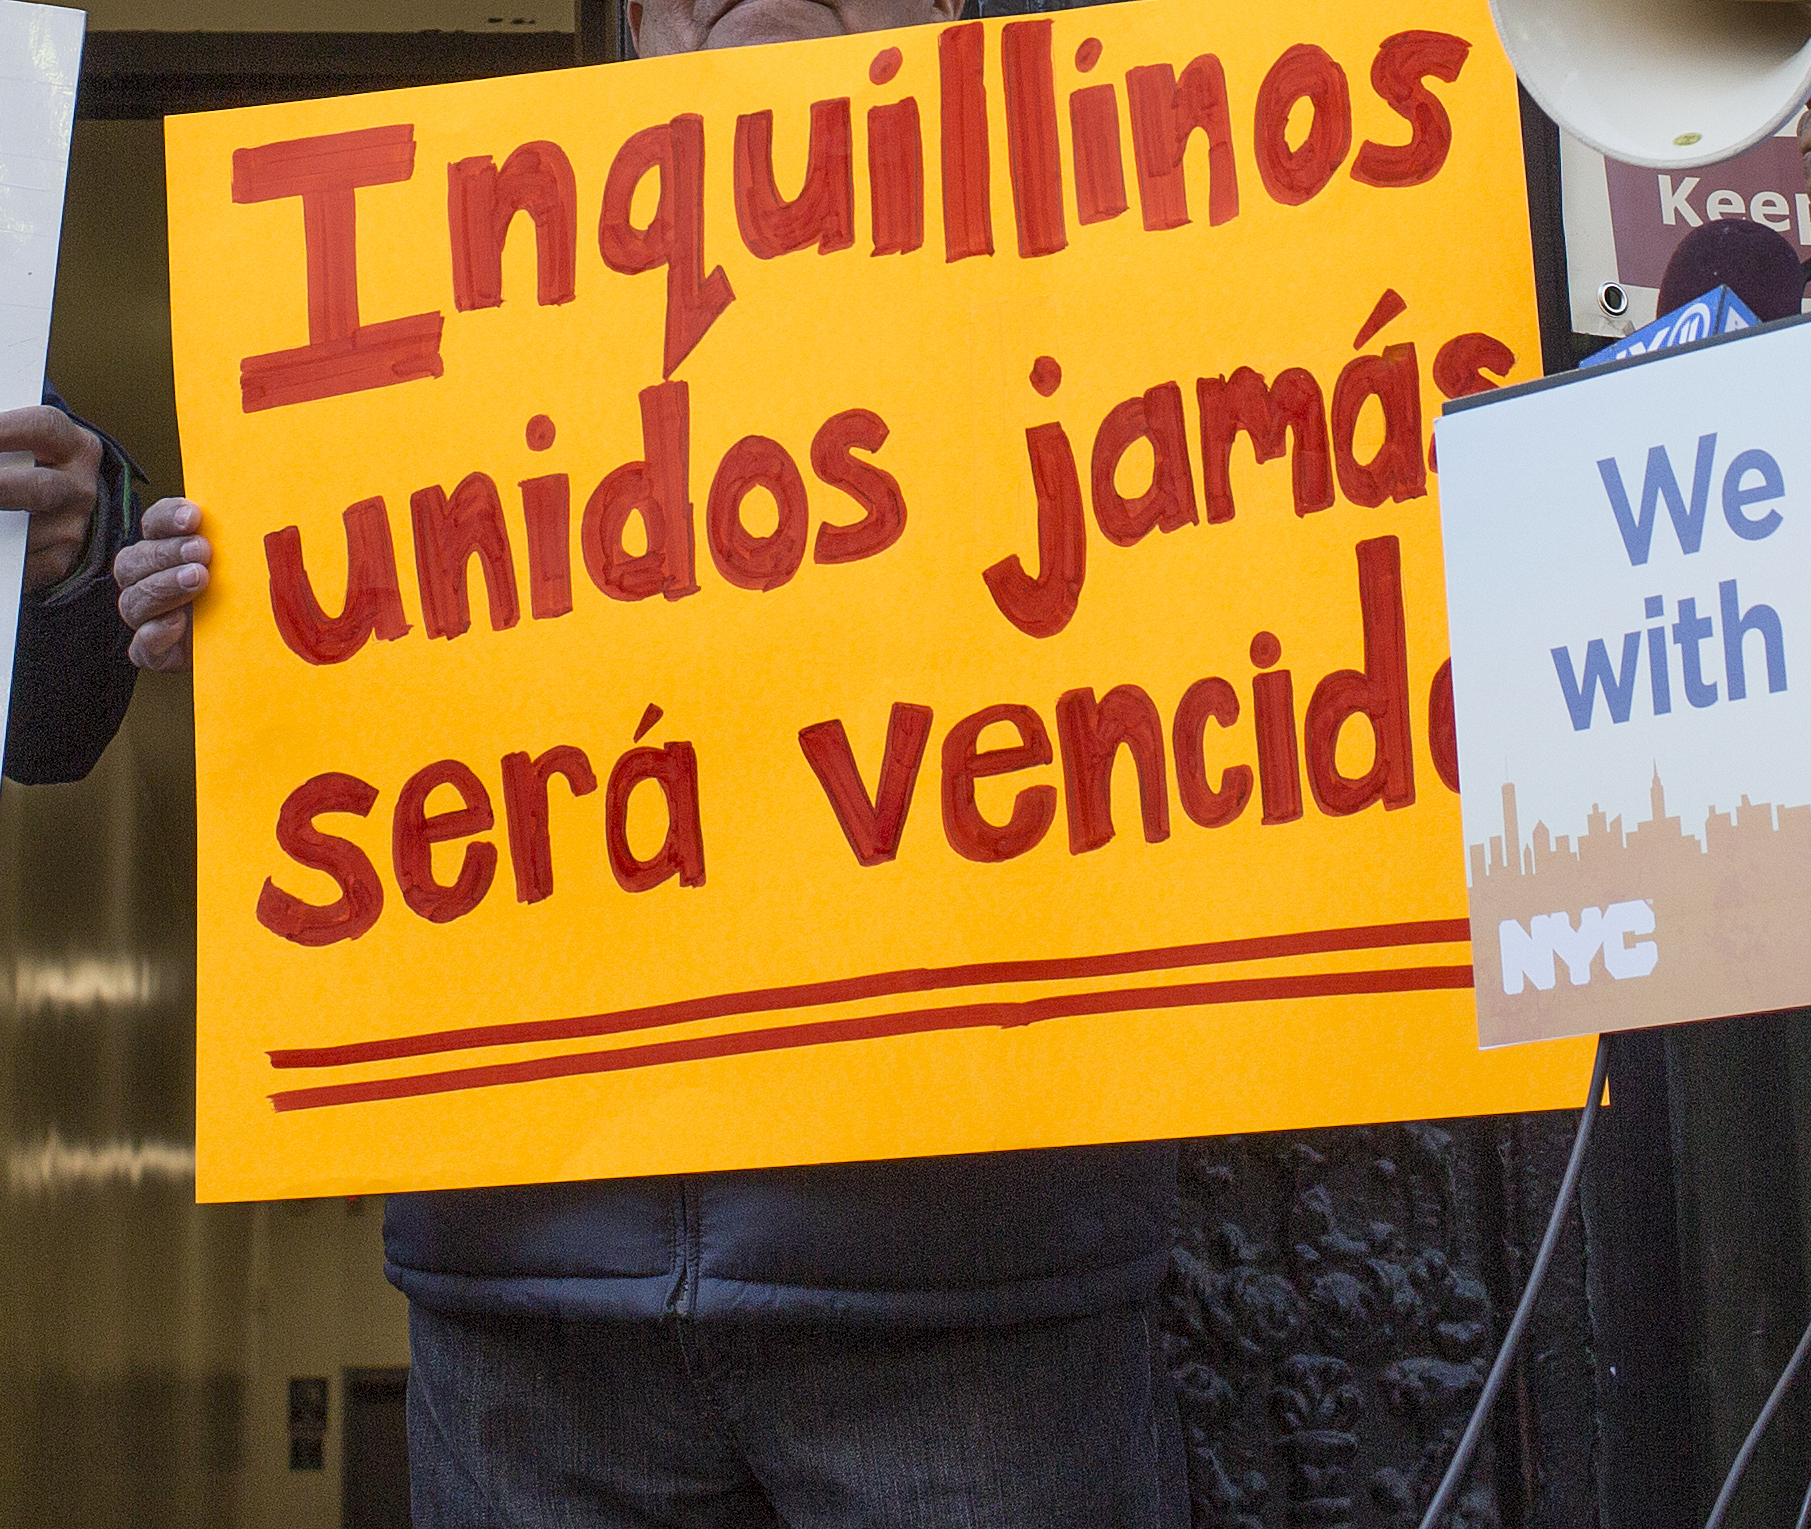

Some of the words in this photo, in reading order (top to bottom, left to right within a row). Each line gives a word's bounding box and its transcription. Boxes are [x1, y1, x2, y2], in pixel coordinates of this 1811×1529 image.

[231, 17, 1473, 414] Inquillinos
[263, 377, 909, 667] unidos
[1596, 431, 1787, 568] We
[1550, 578, 1789, 732] with
[256, 702, 707, 948] será
[1499, 899, 1659, 995] NYC
